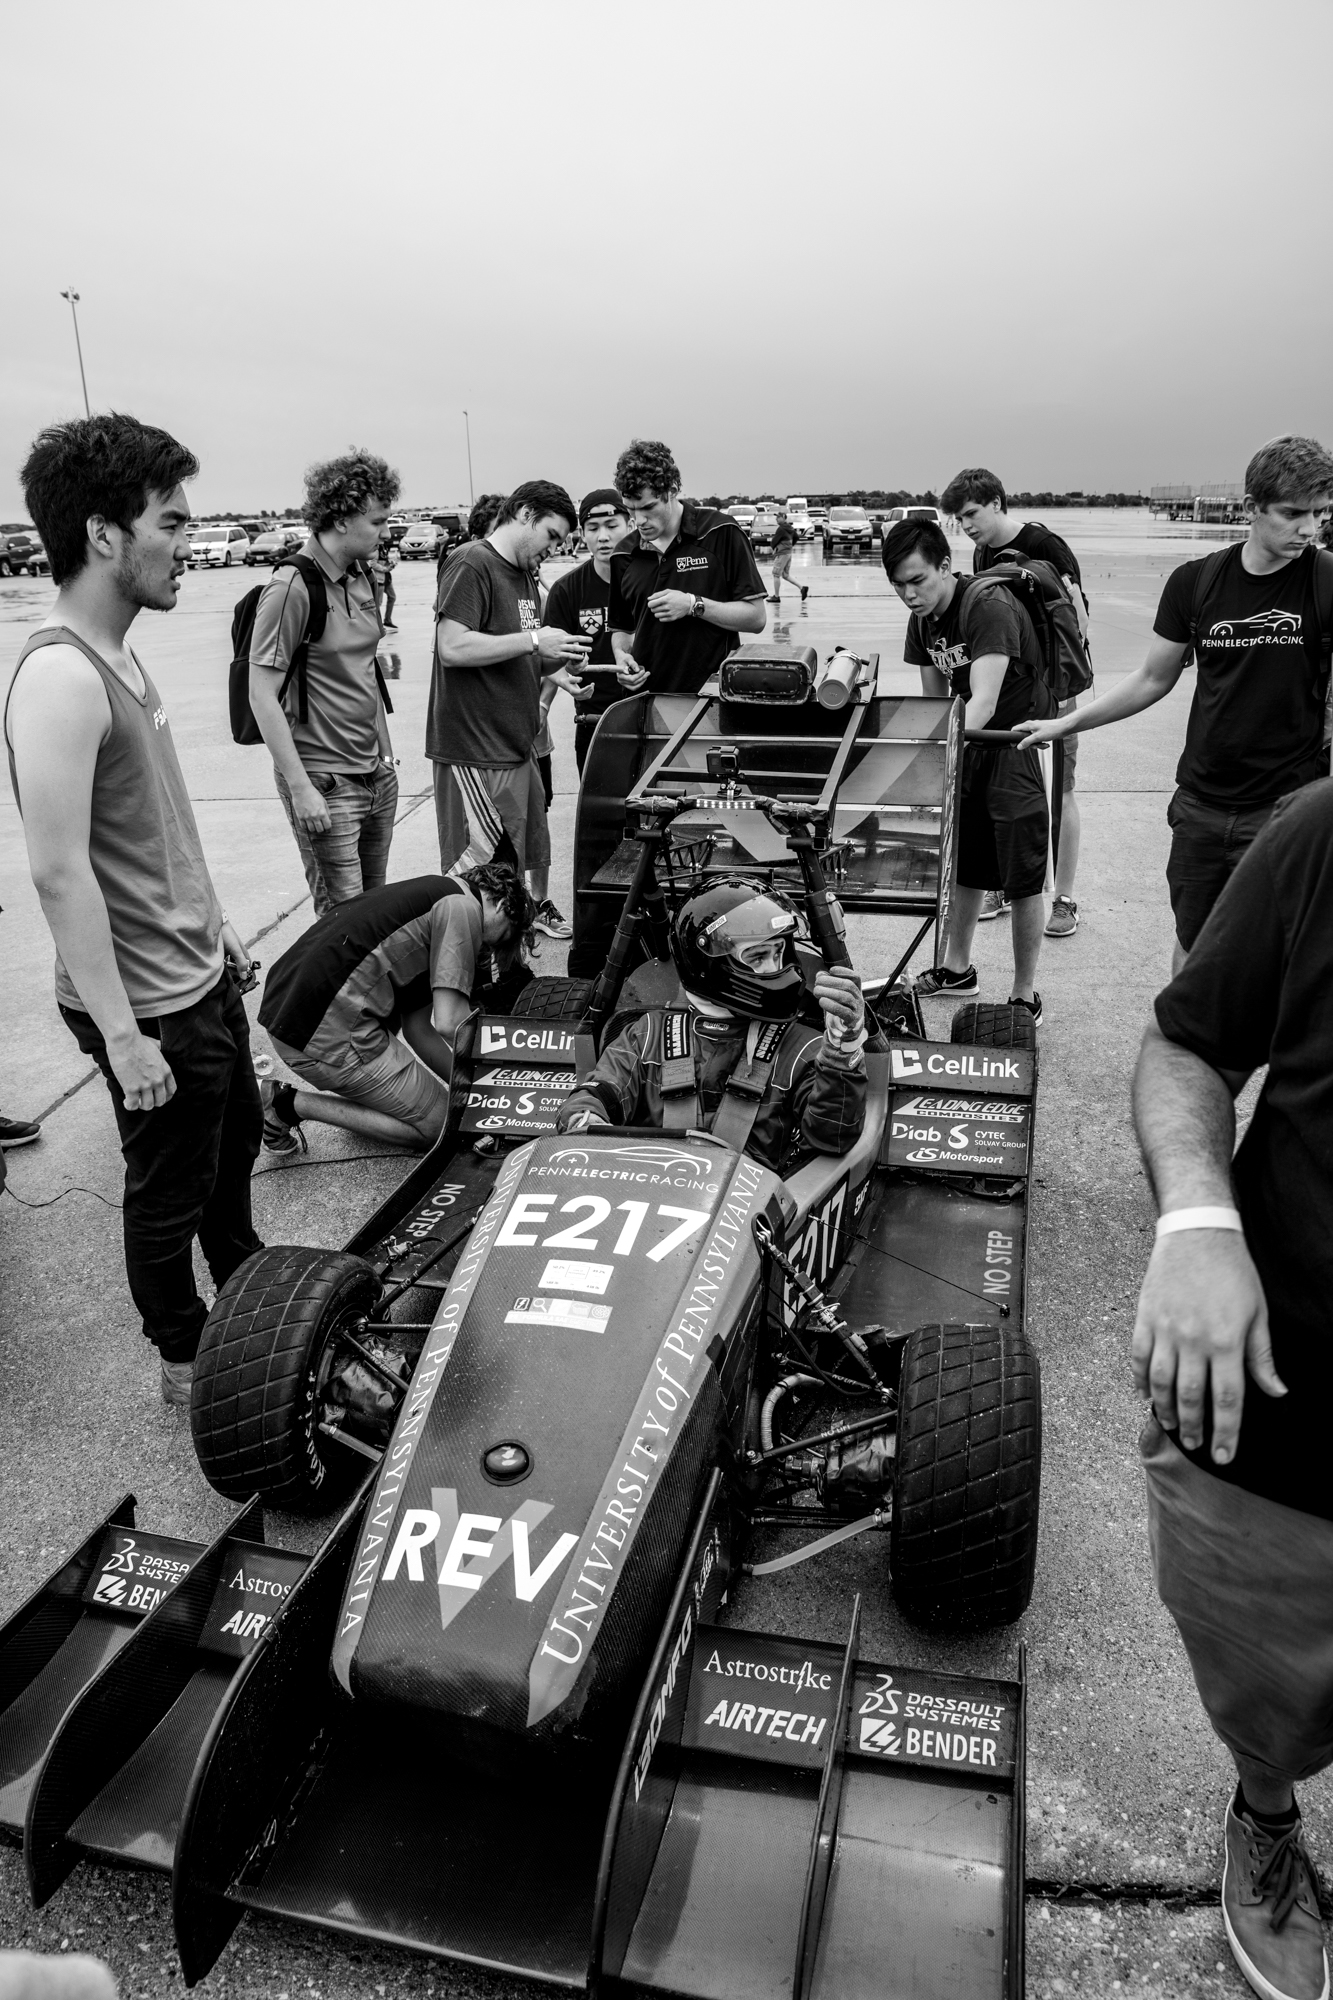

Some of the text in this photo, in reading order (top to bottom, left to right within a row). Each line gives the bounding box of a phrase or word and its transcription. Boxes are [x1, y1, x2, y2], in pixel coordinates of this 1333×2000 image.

[686, 556, 708, 566] Penn
[473, 1068, 554, 1084] LEADING
[927, 1054, 1020, 1078] CelLink
[467, 1093, 511, 1109] Diab
[893, 1096, 1030, 1114] LEADING EDGE
[917, 1110, 1019, 1122] COMPOSITES
[892, 1122, 941, 1141] Diab
[975, 1131, 1005, 1140] CYTEC
[939, 1151, 1004, 1164] Motorsport
[528, 1166, 719, 1193] PENNELECTRICRACING
[405, 1183, 466, 1237] NO STEP
[494, 1194, 711, 1263] E217
[983, 1230, 1013, 1295] NO STEP
[341, 1142, 537, 1637] UNIVERSITY of PENNSYLVANIA
[540, 1162, 764, 1664] UNIVERSITY of PENNSYLVANIA
[142, 1555, 190, 1573] DASSA
[382, 1509, 580, 1602] REV
[220, 1610, 271, 1639] AIR
[907, 1692, 1005, 1718] DASSAULT
[704, 1699, 827, 1745] AIRTECH
[906, 1727, 997, 1766] BENDER
